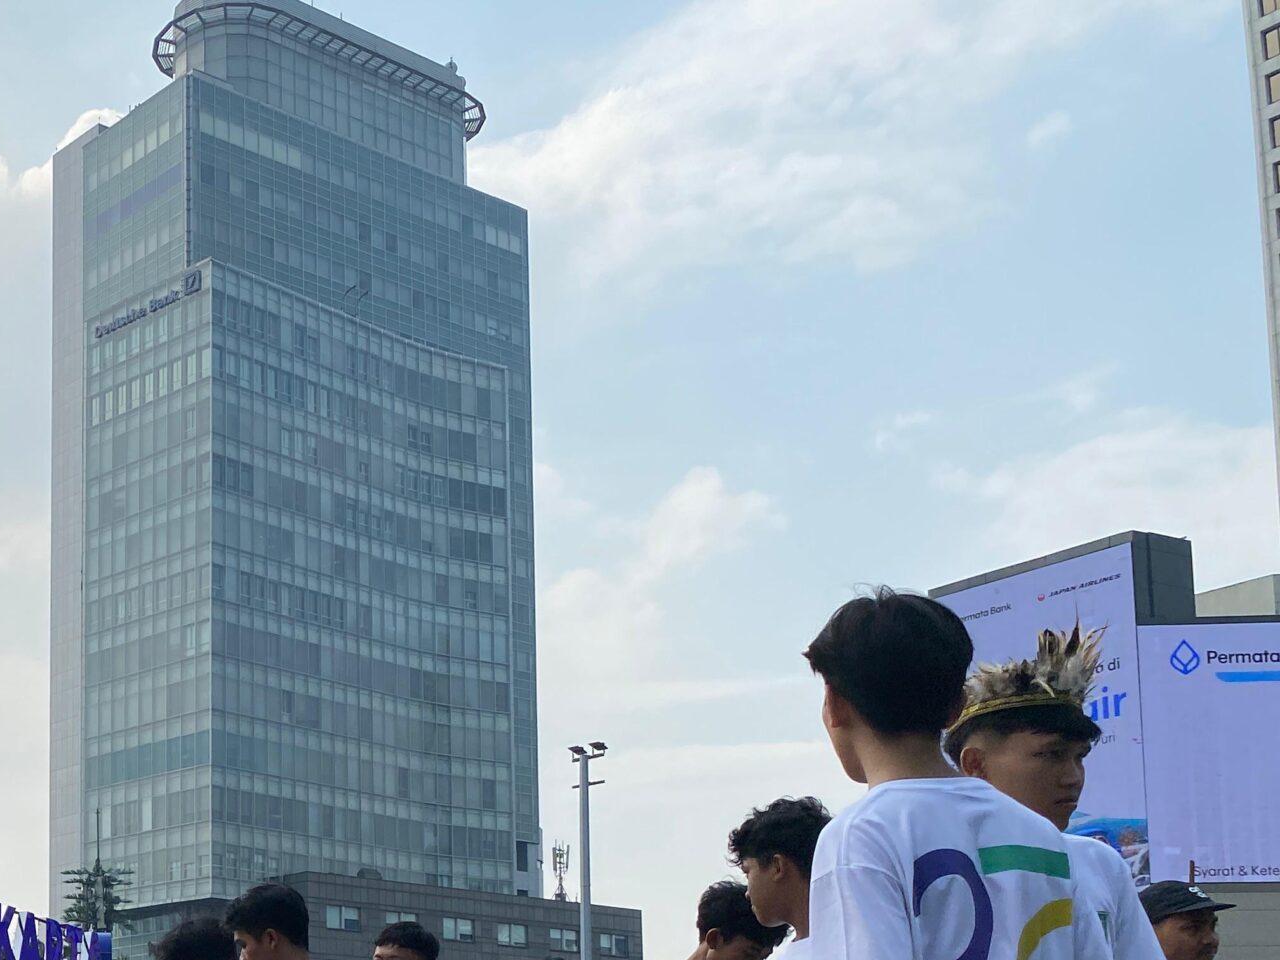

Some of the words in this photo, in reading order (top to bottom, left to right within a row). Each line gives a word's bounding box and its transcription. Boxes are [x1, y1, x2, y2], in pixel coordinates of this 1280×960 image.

[95, 308, 147, 337] Deutsche
[149, 290, 181, 312] Bank
[1048, 586, 1077, 598] JAPAN
[1079, 573, 1122, 590] AIRLINES
[990, 603, 1012, 615] Bank
[1207, 650, 1280, 664] Permata
[1194, 865, 1234, 878] Syarat
[1239, 865, 1249, 877] &
